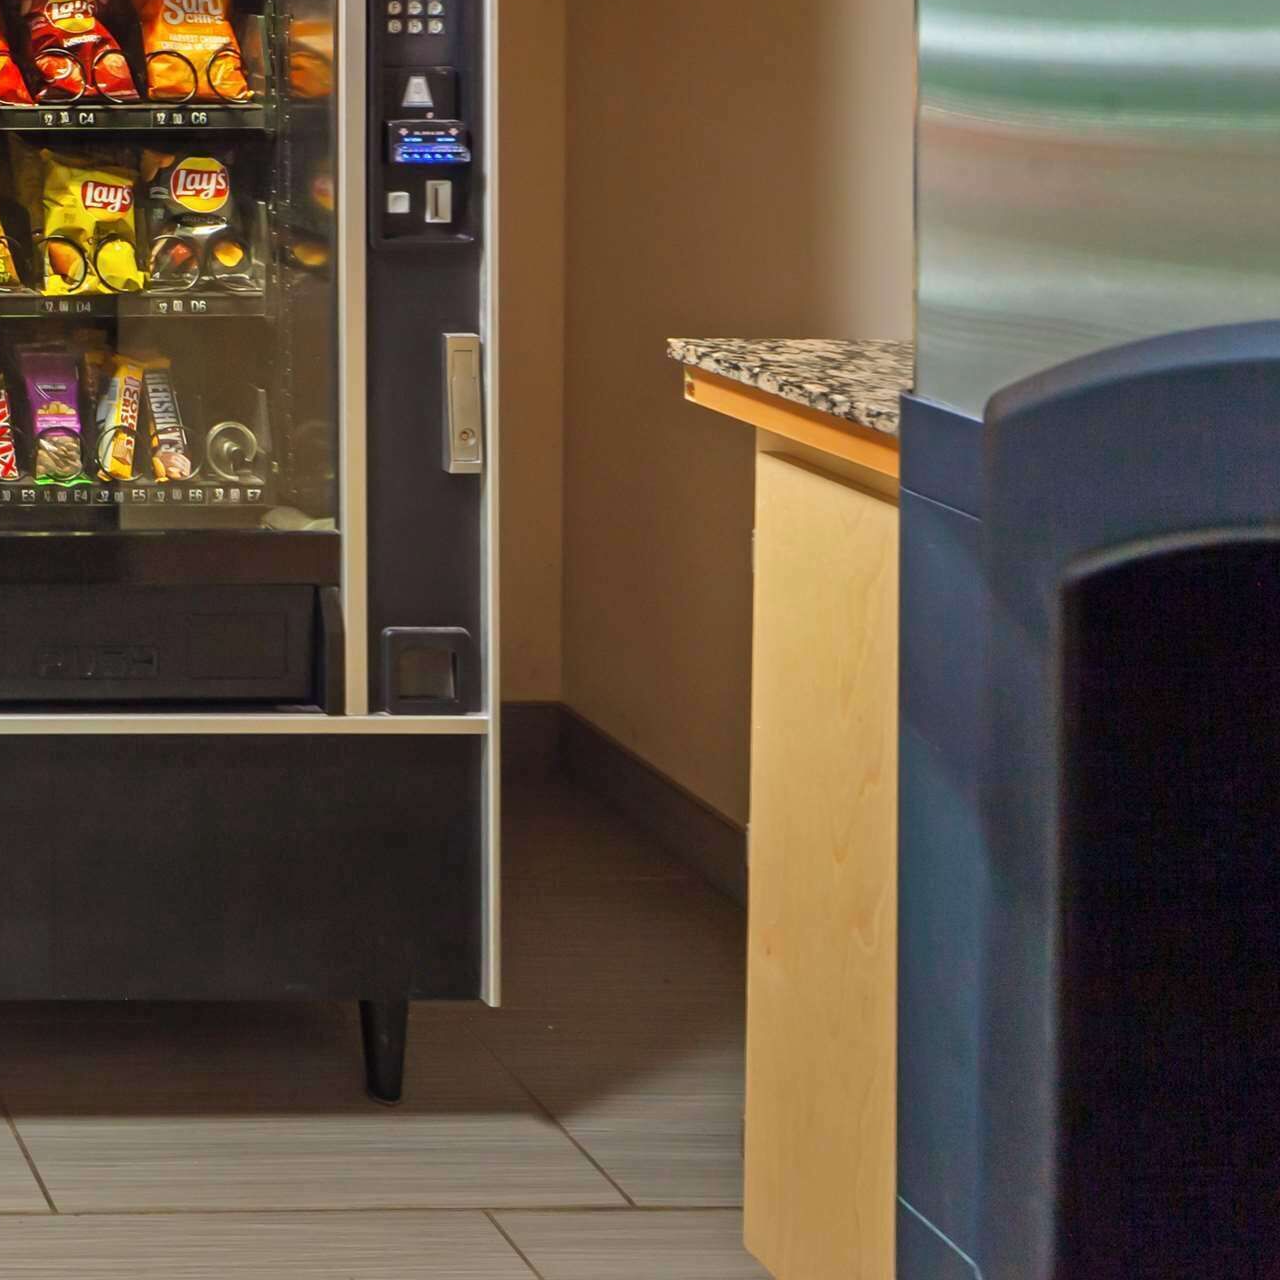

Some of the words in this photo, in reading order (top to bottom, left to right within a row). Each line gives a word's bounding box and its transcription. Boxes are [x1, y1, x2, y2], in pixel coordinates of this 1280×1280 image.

[79, 112, 95, 125] C4
[191, 112, 207, 125] C6
[176, 170, 227, 200] Lay's
[85, 182, 132, 213] Lay's
[191, 300, 207, 312] D6
[21, 490, 37, 500] E3
